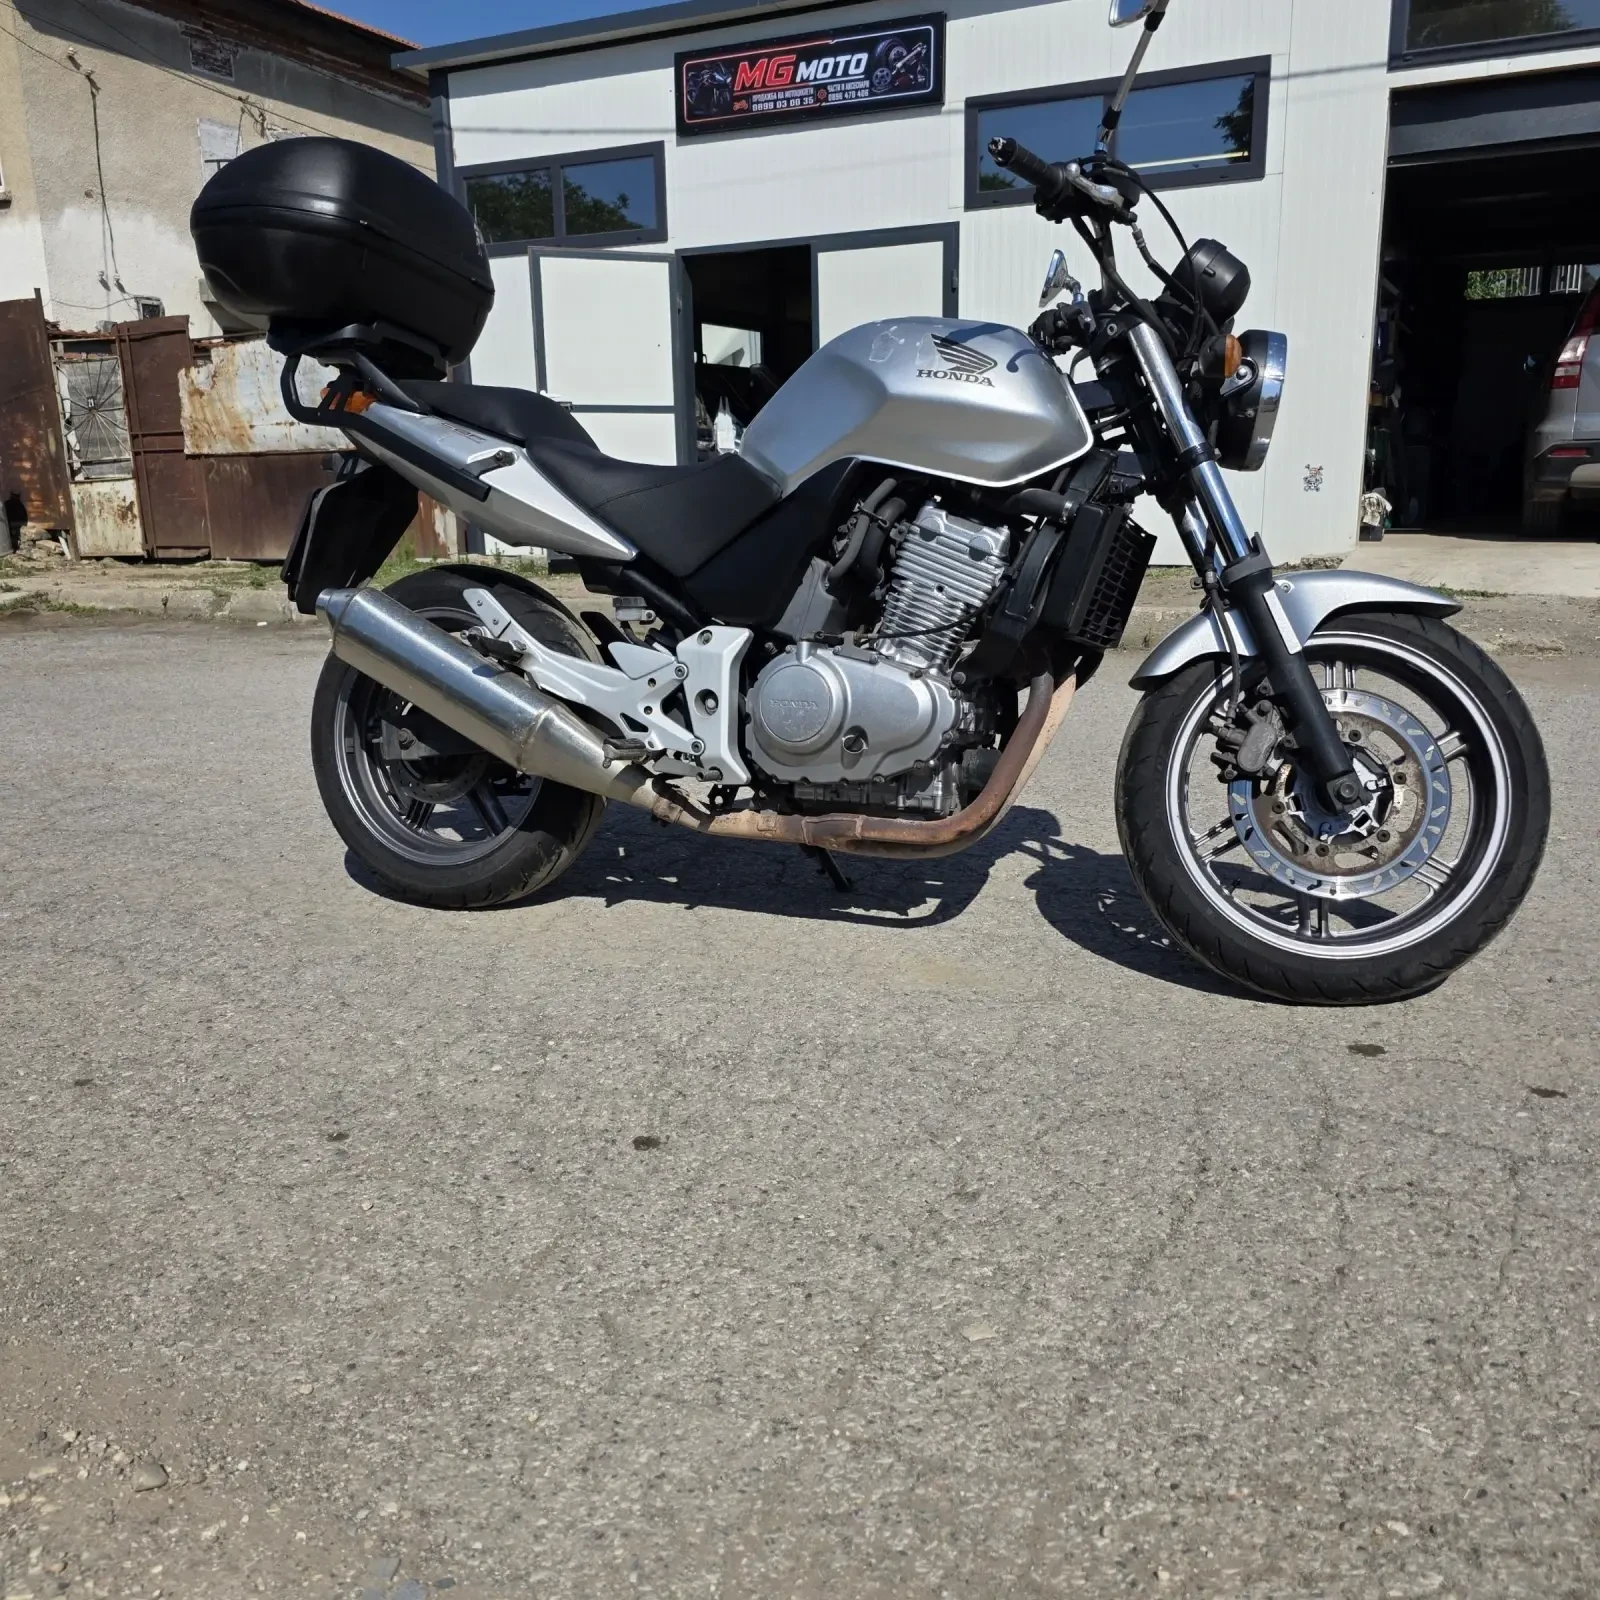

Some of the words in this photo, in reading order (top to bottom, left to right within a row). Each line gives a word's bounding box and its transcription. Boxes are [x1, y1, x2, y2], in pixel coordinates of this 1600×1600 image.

[734, 54, 796, 91] MG
[796, 52, 868, 82] MOTO
[776, 100, 787, 109] 03
[790, 98, 801, 107] 00
[803, 96, 814, 105] 35
[844, 90, 856, 99] 470
[916, 369, 995, 388] HONDA
